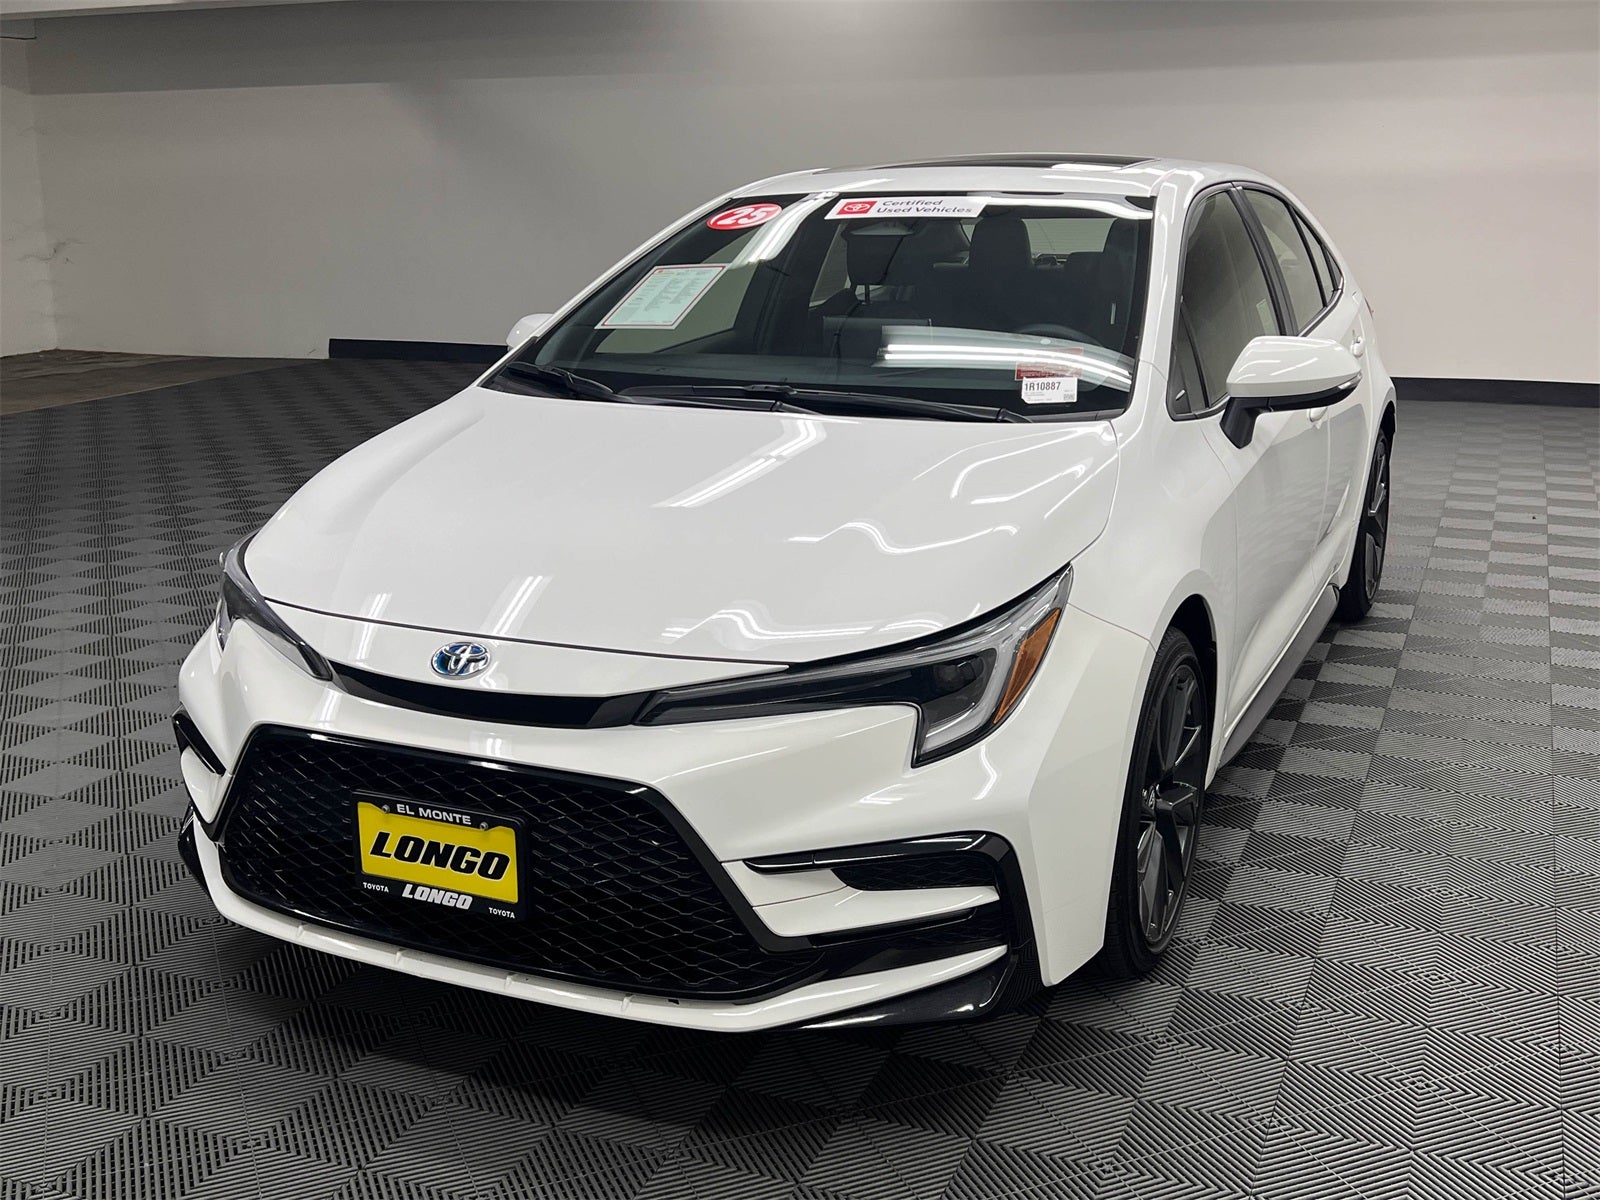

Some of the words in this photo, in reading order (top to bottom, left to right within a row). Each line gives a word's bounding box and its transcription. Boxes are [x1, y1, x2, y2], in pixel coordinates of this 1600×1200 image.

[717, 207, 778, 225] 25
[1024, 381, 1061, 391] 1R10887
[396, 803, 415, 815] EL
[418, 807, 472, 825] MONTE
[369, 831, 511, 881] LONGO
[362, 882, 389, 893] TOYOTA
[402, 883, 473, 910] LONGO
[488, 907, 516, 919] TOYOTA
